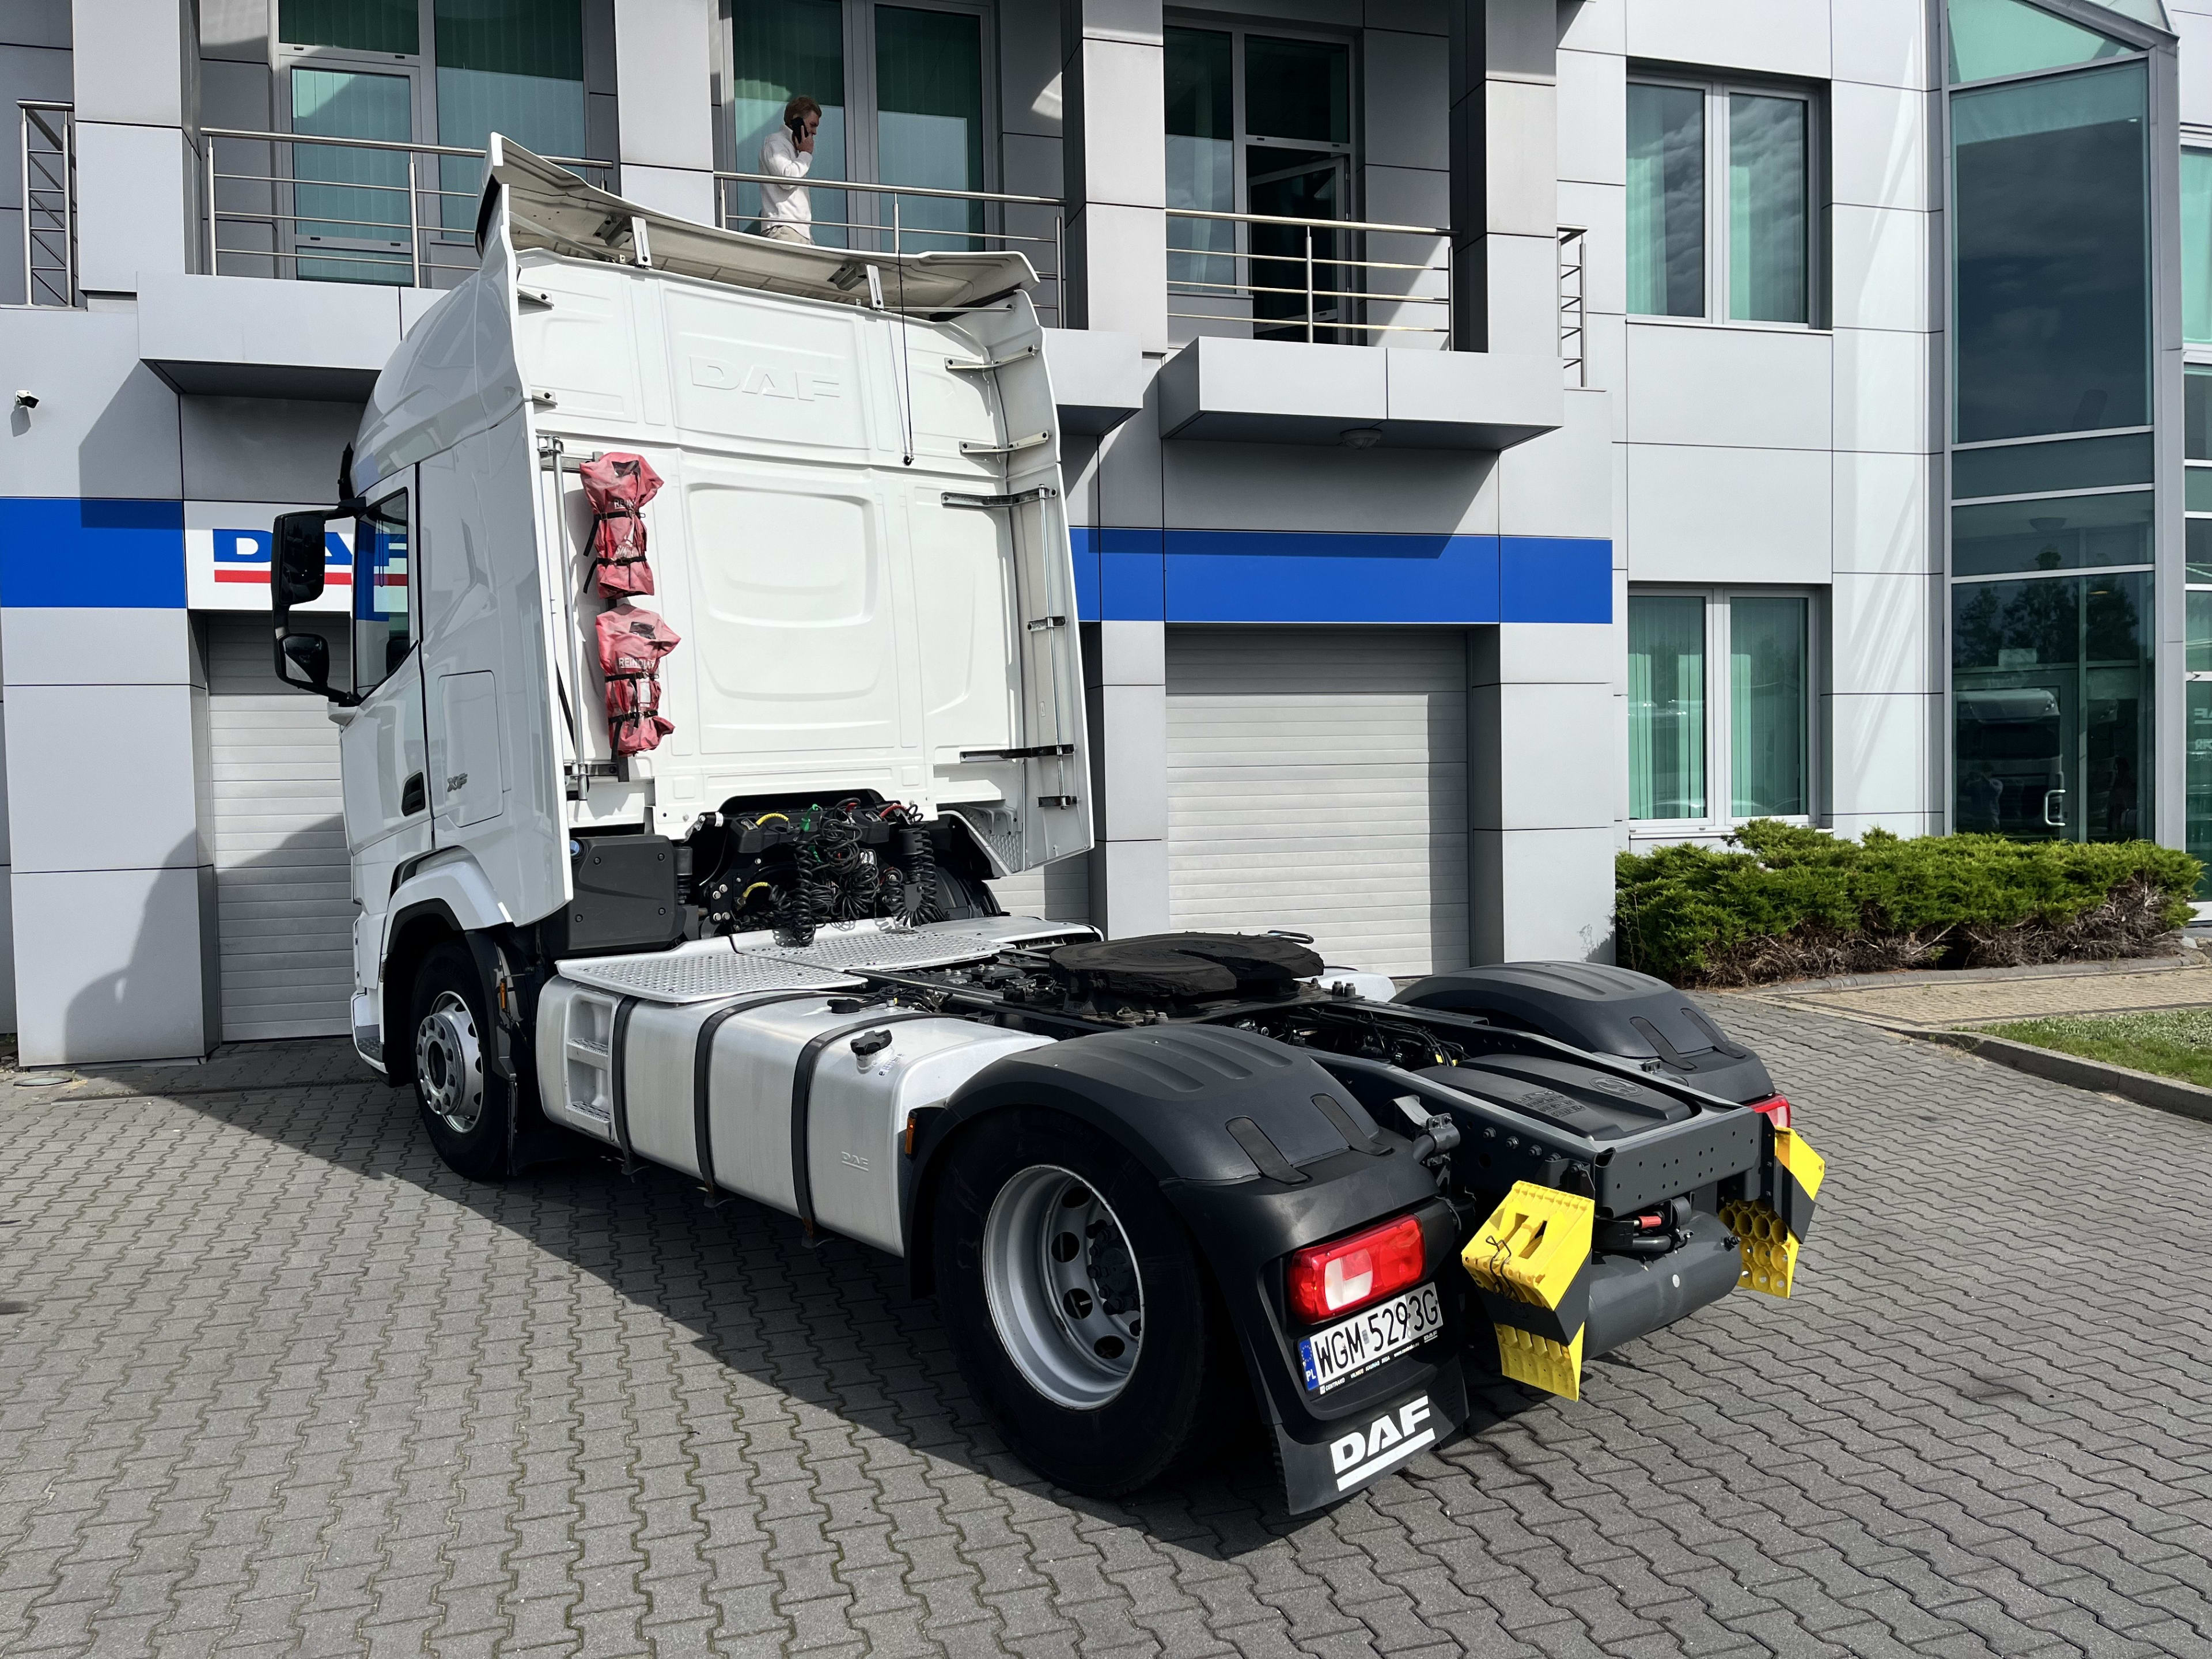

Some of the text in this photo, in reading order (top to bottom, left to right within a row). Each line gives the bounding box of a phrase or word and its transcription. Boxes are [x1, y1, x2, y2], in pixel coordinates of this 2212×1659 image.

[689, 355, 840, 402] DAF
[447, 772, 468, 792] XF
[841, 1151, 869, 1165] DAF
[1315, 1290, 1438, 1378] WGM 5293G
[1305, 1369, 1316, 1382] PL
[1325, 1377, 1345, 1391] CENTRAKO
[1365, 1360, 1380, 1372] KAUNAS
[1381, 1355, 1391, 1363] RIGA
[1423, 1330, 1437, 1341] DAF
[1330, 1395, 1430, 1474] DAF
